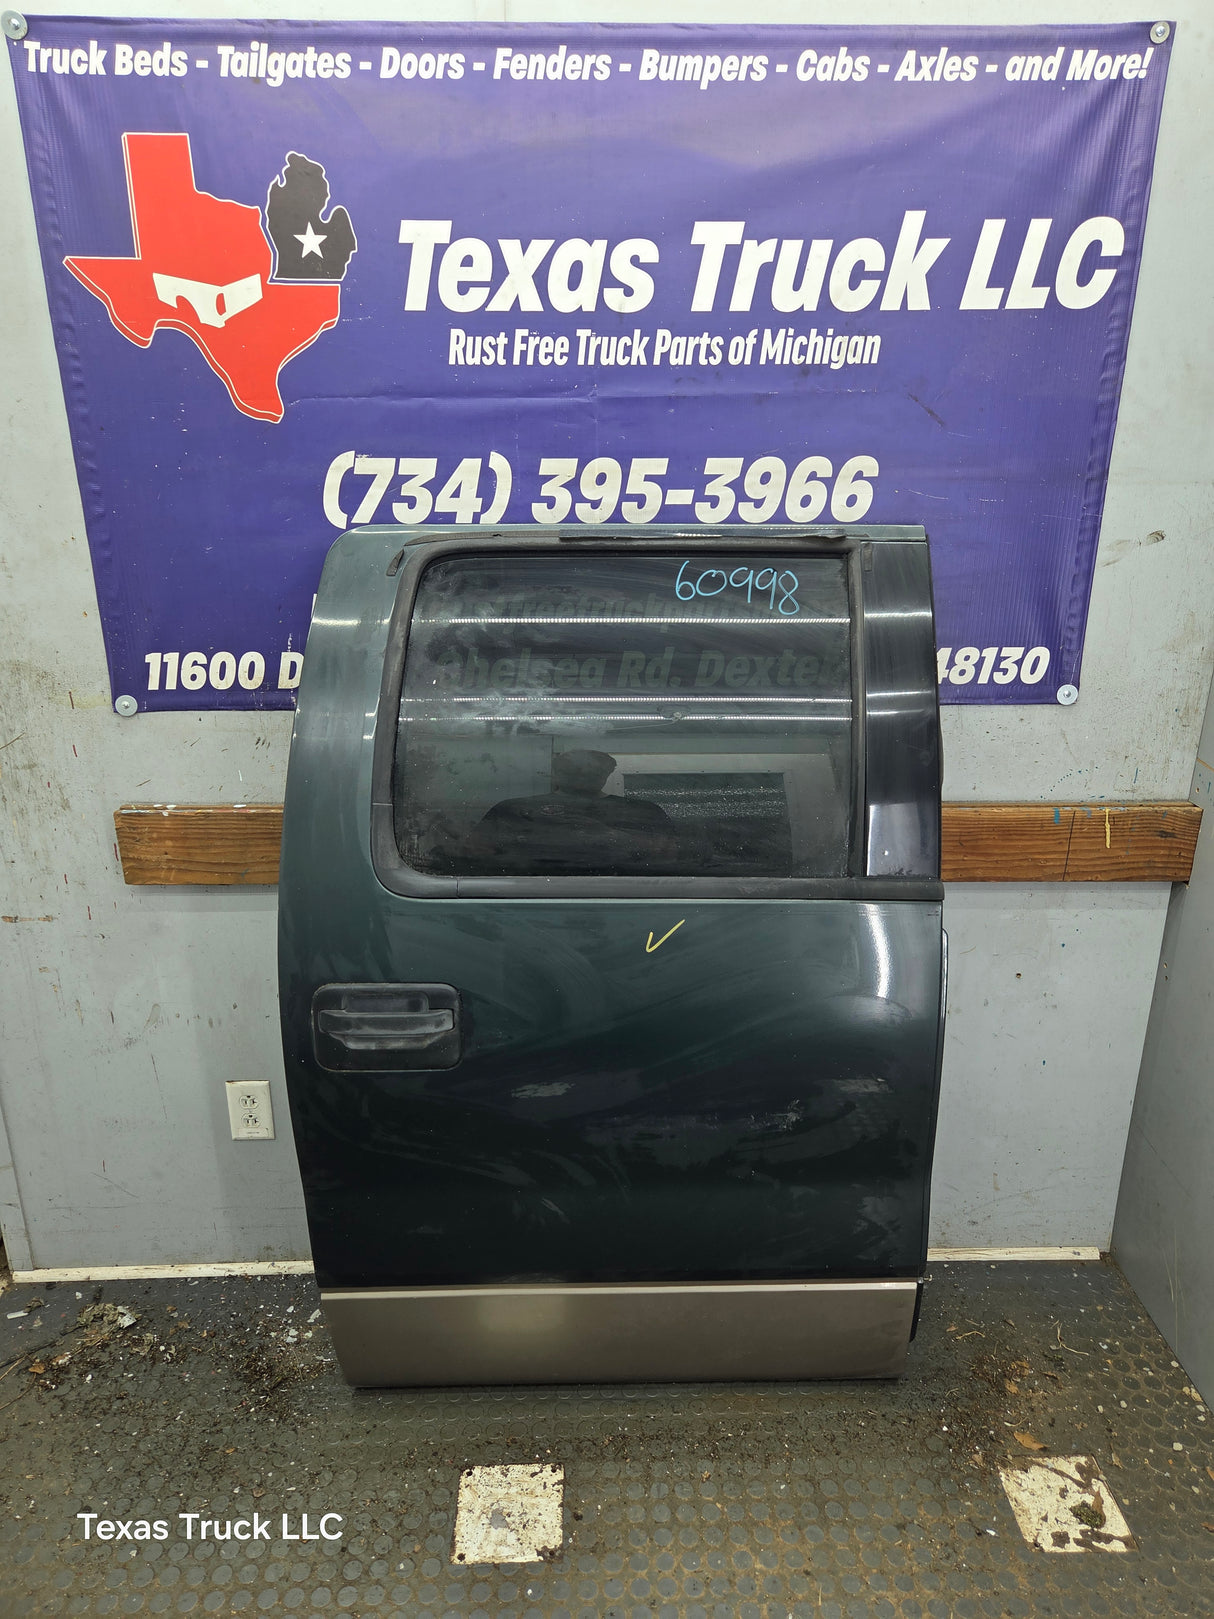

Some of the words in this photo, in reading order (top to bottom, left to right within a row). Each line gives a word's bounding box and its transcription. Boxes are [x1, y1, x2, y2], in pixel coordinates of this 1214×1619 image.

[23, 40, 108, 75] Truck
[114, 41, 188, 77] Beds
[217, 41, 352, 87] Tailgates
[379, 47, 466, 80] Doors
[492, 45, 612, 81] Fenders
[638, 49, 769, 90] Bumpers
[796, 47, 871, 81] Cabs
[894, 48, 979, 82] Axles
[1005, 46, 1066, 82] and
[1065, 47, 1155, 81] More!
[398, 219, 660, 314] Texas
[690, 210, 952, 313] Truck
[959, 215, 1126, 311] LLC
[448, 328, 509, 366] Rust
[512, 328, 570, 366] Free
[575, 328, 651, 367] Truck
[652, 328, 724, 366] Parts
[728, 328, 759, 366] of
[759, 327, 882, 370] Michigan
[322, 450, 513, 530] (734)
[531, 455, 880, 524] 395-3966
[675, 560, 799, 616] 60998
[144, 651, 266, 691] 11600
[937, 646, 1051, 685] 48130
